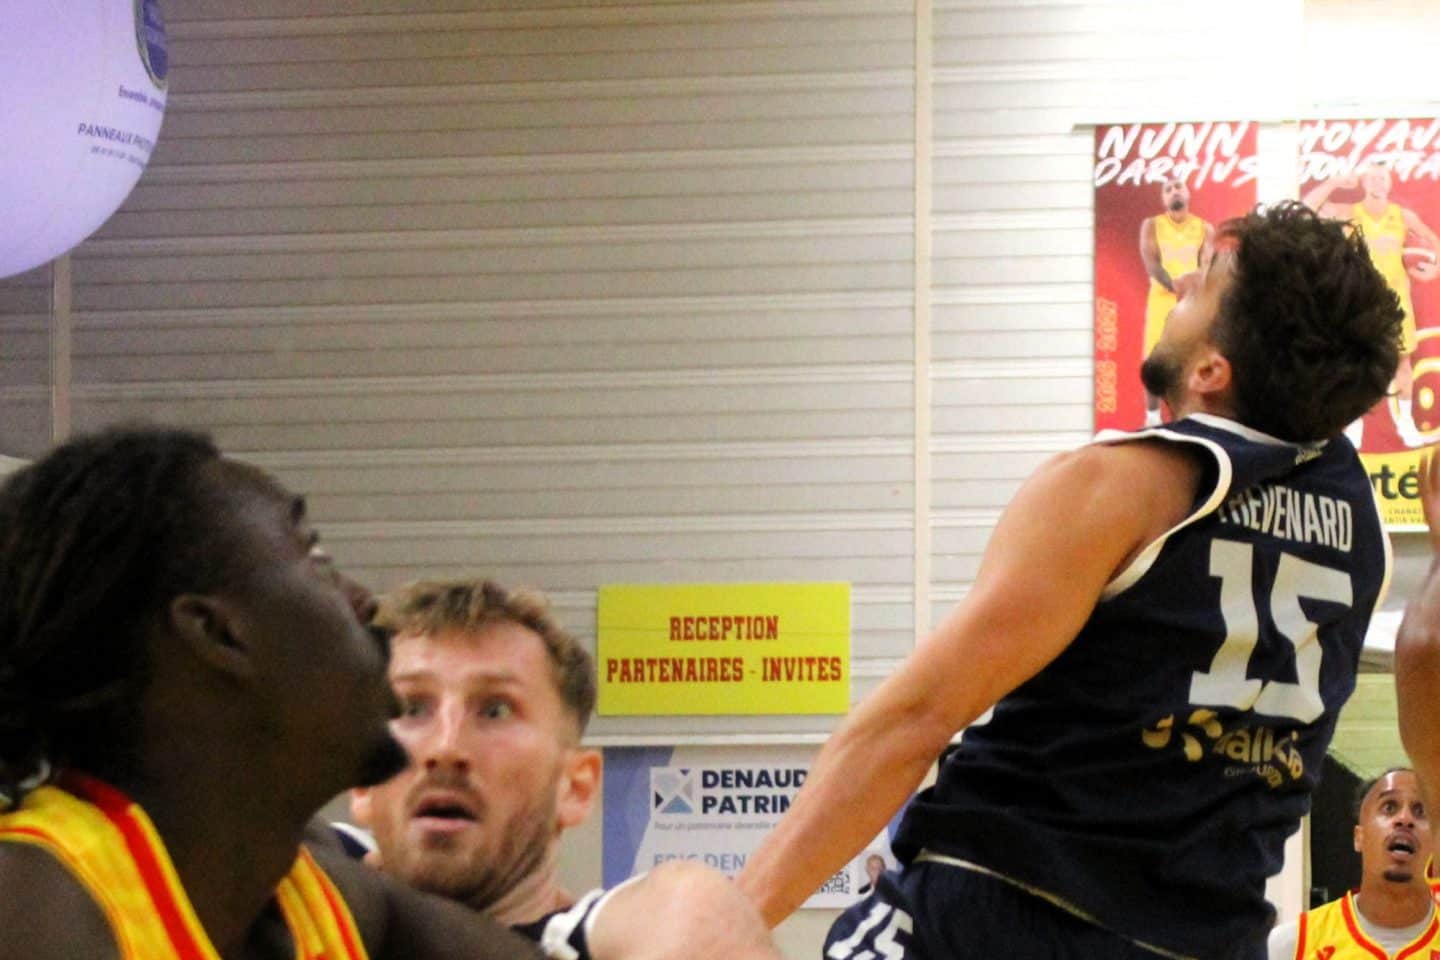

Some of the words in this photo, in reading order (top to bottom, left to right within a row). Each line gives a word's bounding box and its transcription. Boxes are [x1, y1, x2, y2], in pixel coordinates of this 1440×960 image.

[1099, 121, 1250, 160] NUNN
[1219, 485, 1353, 553] HEVENARD
[669, 615, 780, 641] RECEPTION
[1188, 537, 1353, 725] 15
[606, 657, 744, 683] PARTENAIRES
[762, 656, 842, 682] INVITES
